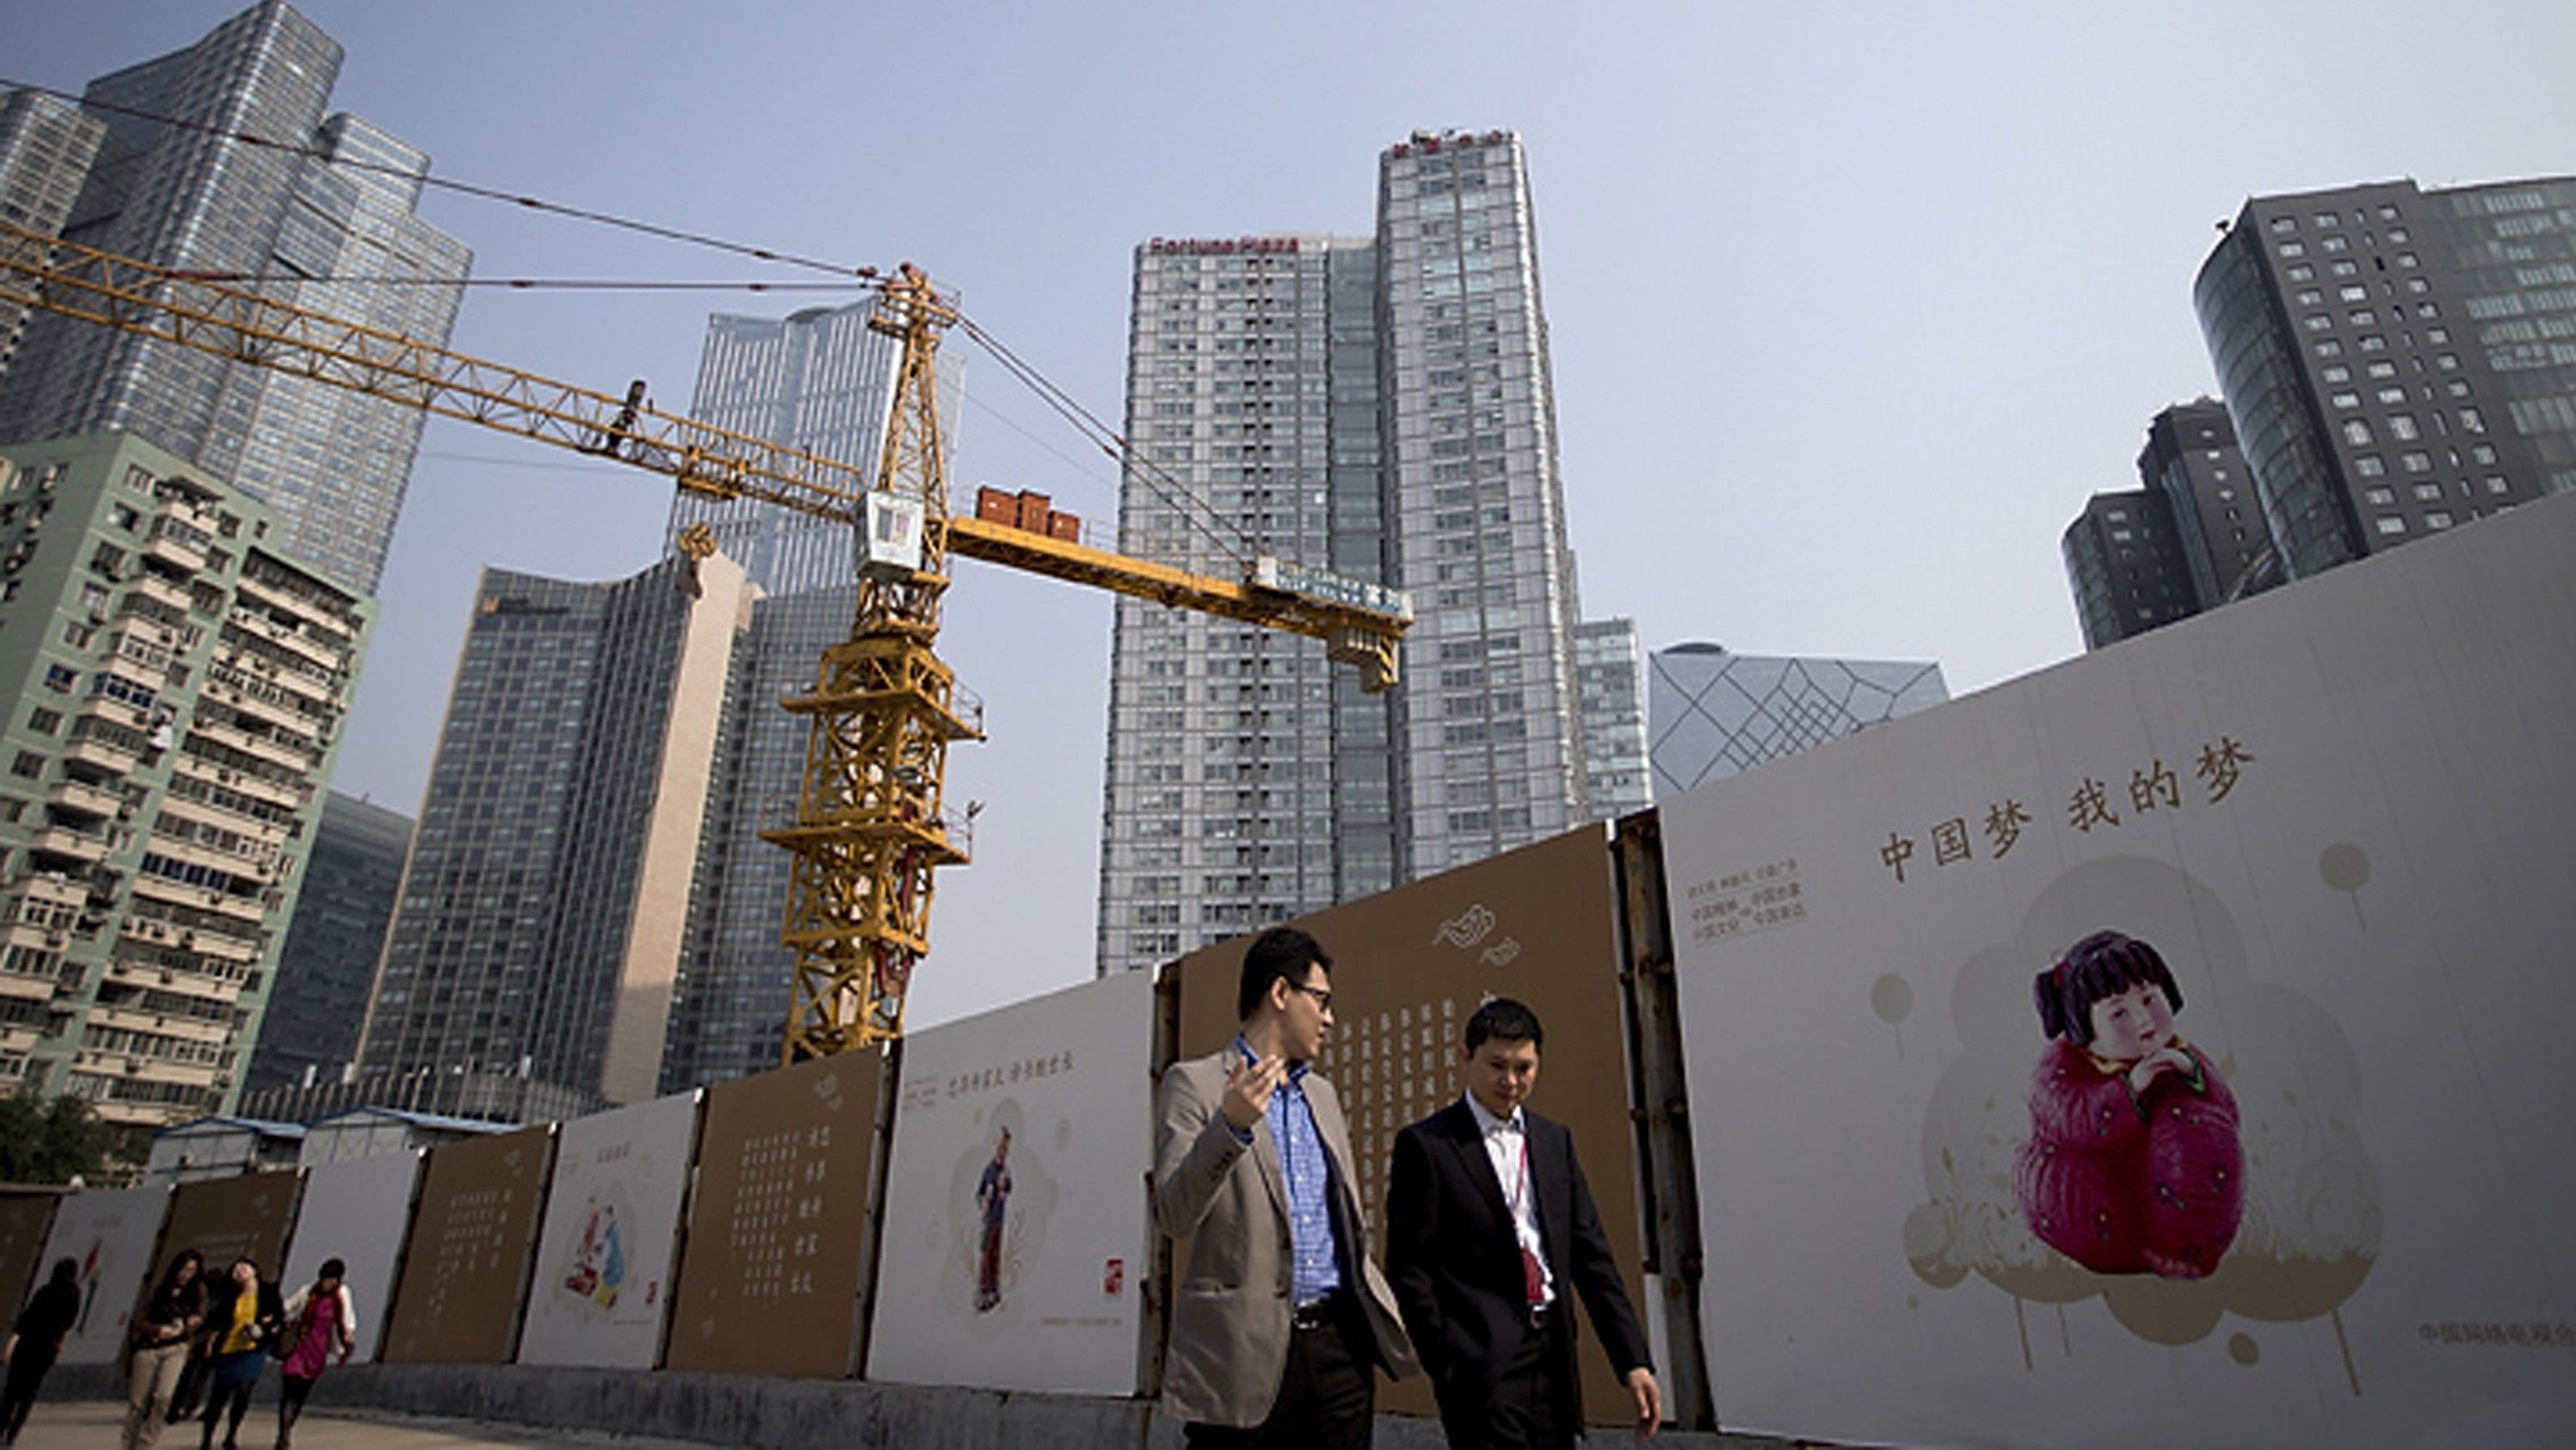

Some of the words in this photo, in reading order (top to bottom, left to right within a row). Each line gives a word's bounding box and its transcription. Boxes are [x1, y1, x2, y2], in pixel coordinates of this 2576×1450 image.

[1151, 237, 1234, 255] Fortune
[1240, 236, 1299, 255] Plaza
[1879, 799, 2033, 883] 中国梦
[2068, 736, 2256, 834] 我的梦
